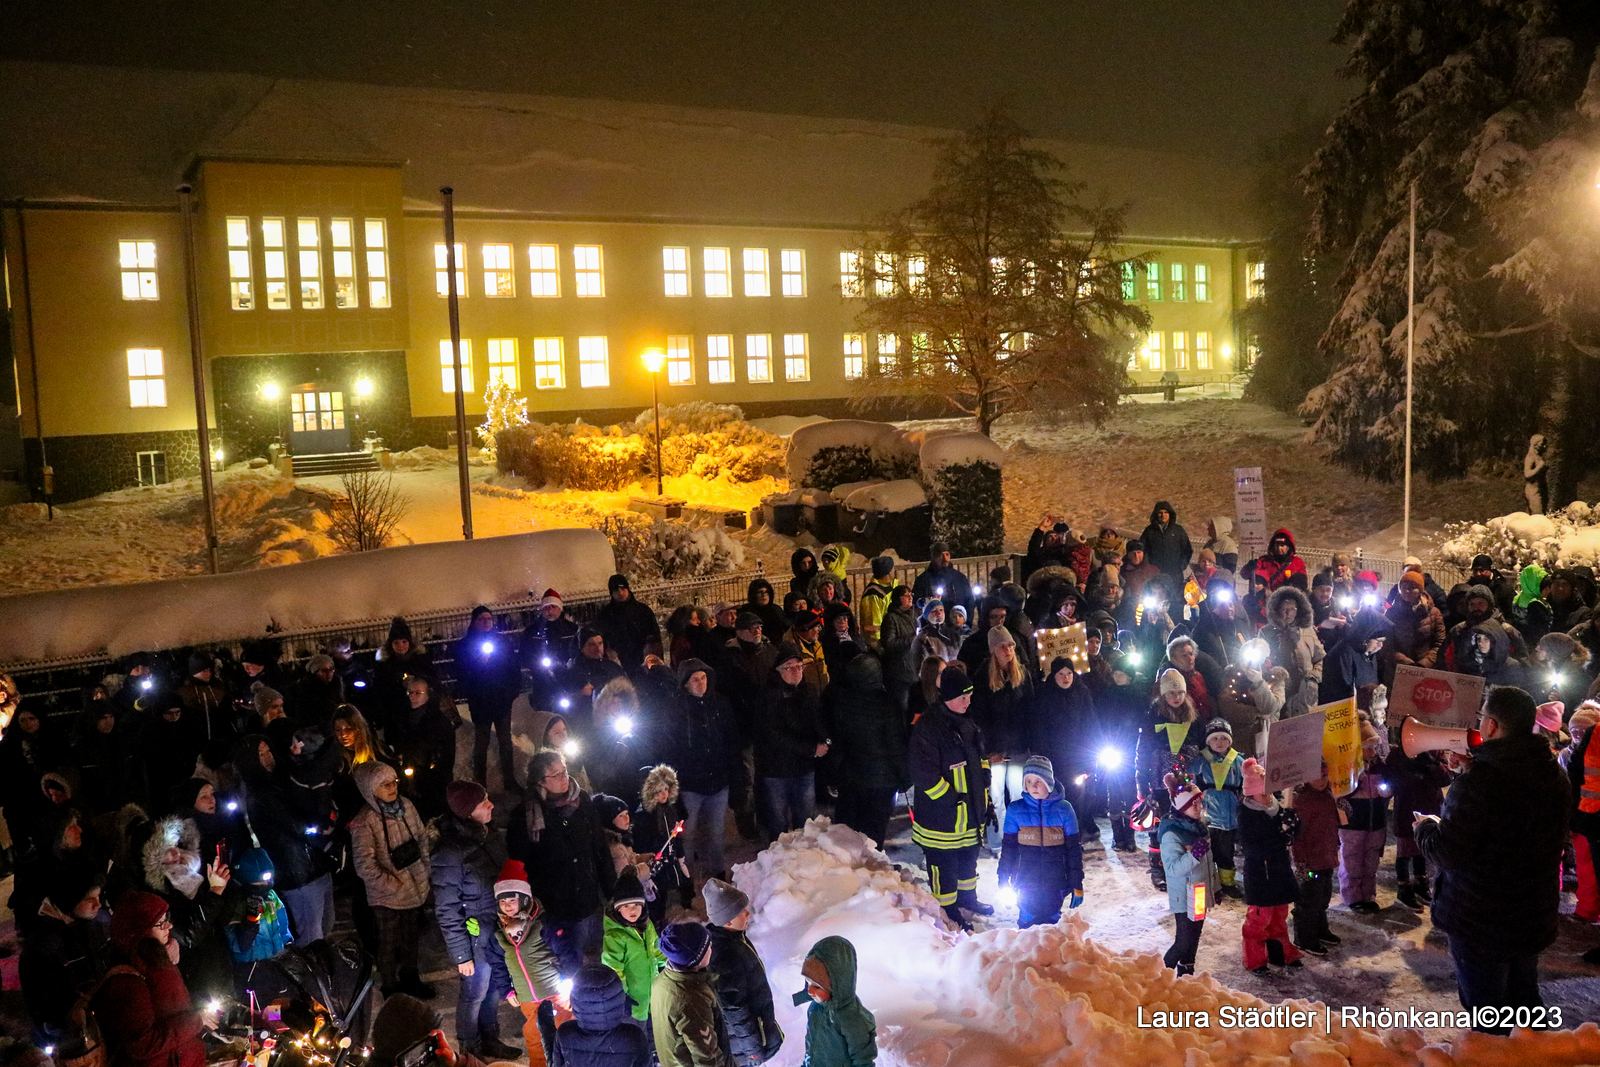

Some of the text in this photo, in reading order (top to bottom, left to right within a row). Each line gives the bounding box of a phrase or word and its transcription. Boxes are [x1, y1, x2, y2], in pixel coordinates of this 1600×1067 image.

[1415, 686, 1452, 702] STOP
[1325, 708, 1350, 722] NSERE
[1338, 742, 1352, 753] MIT
